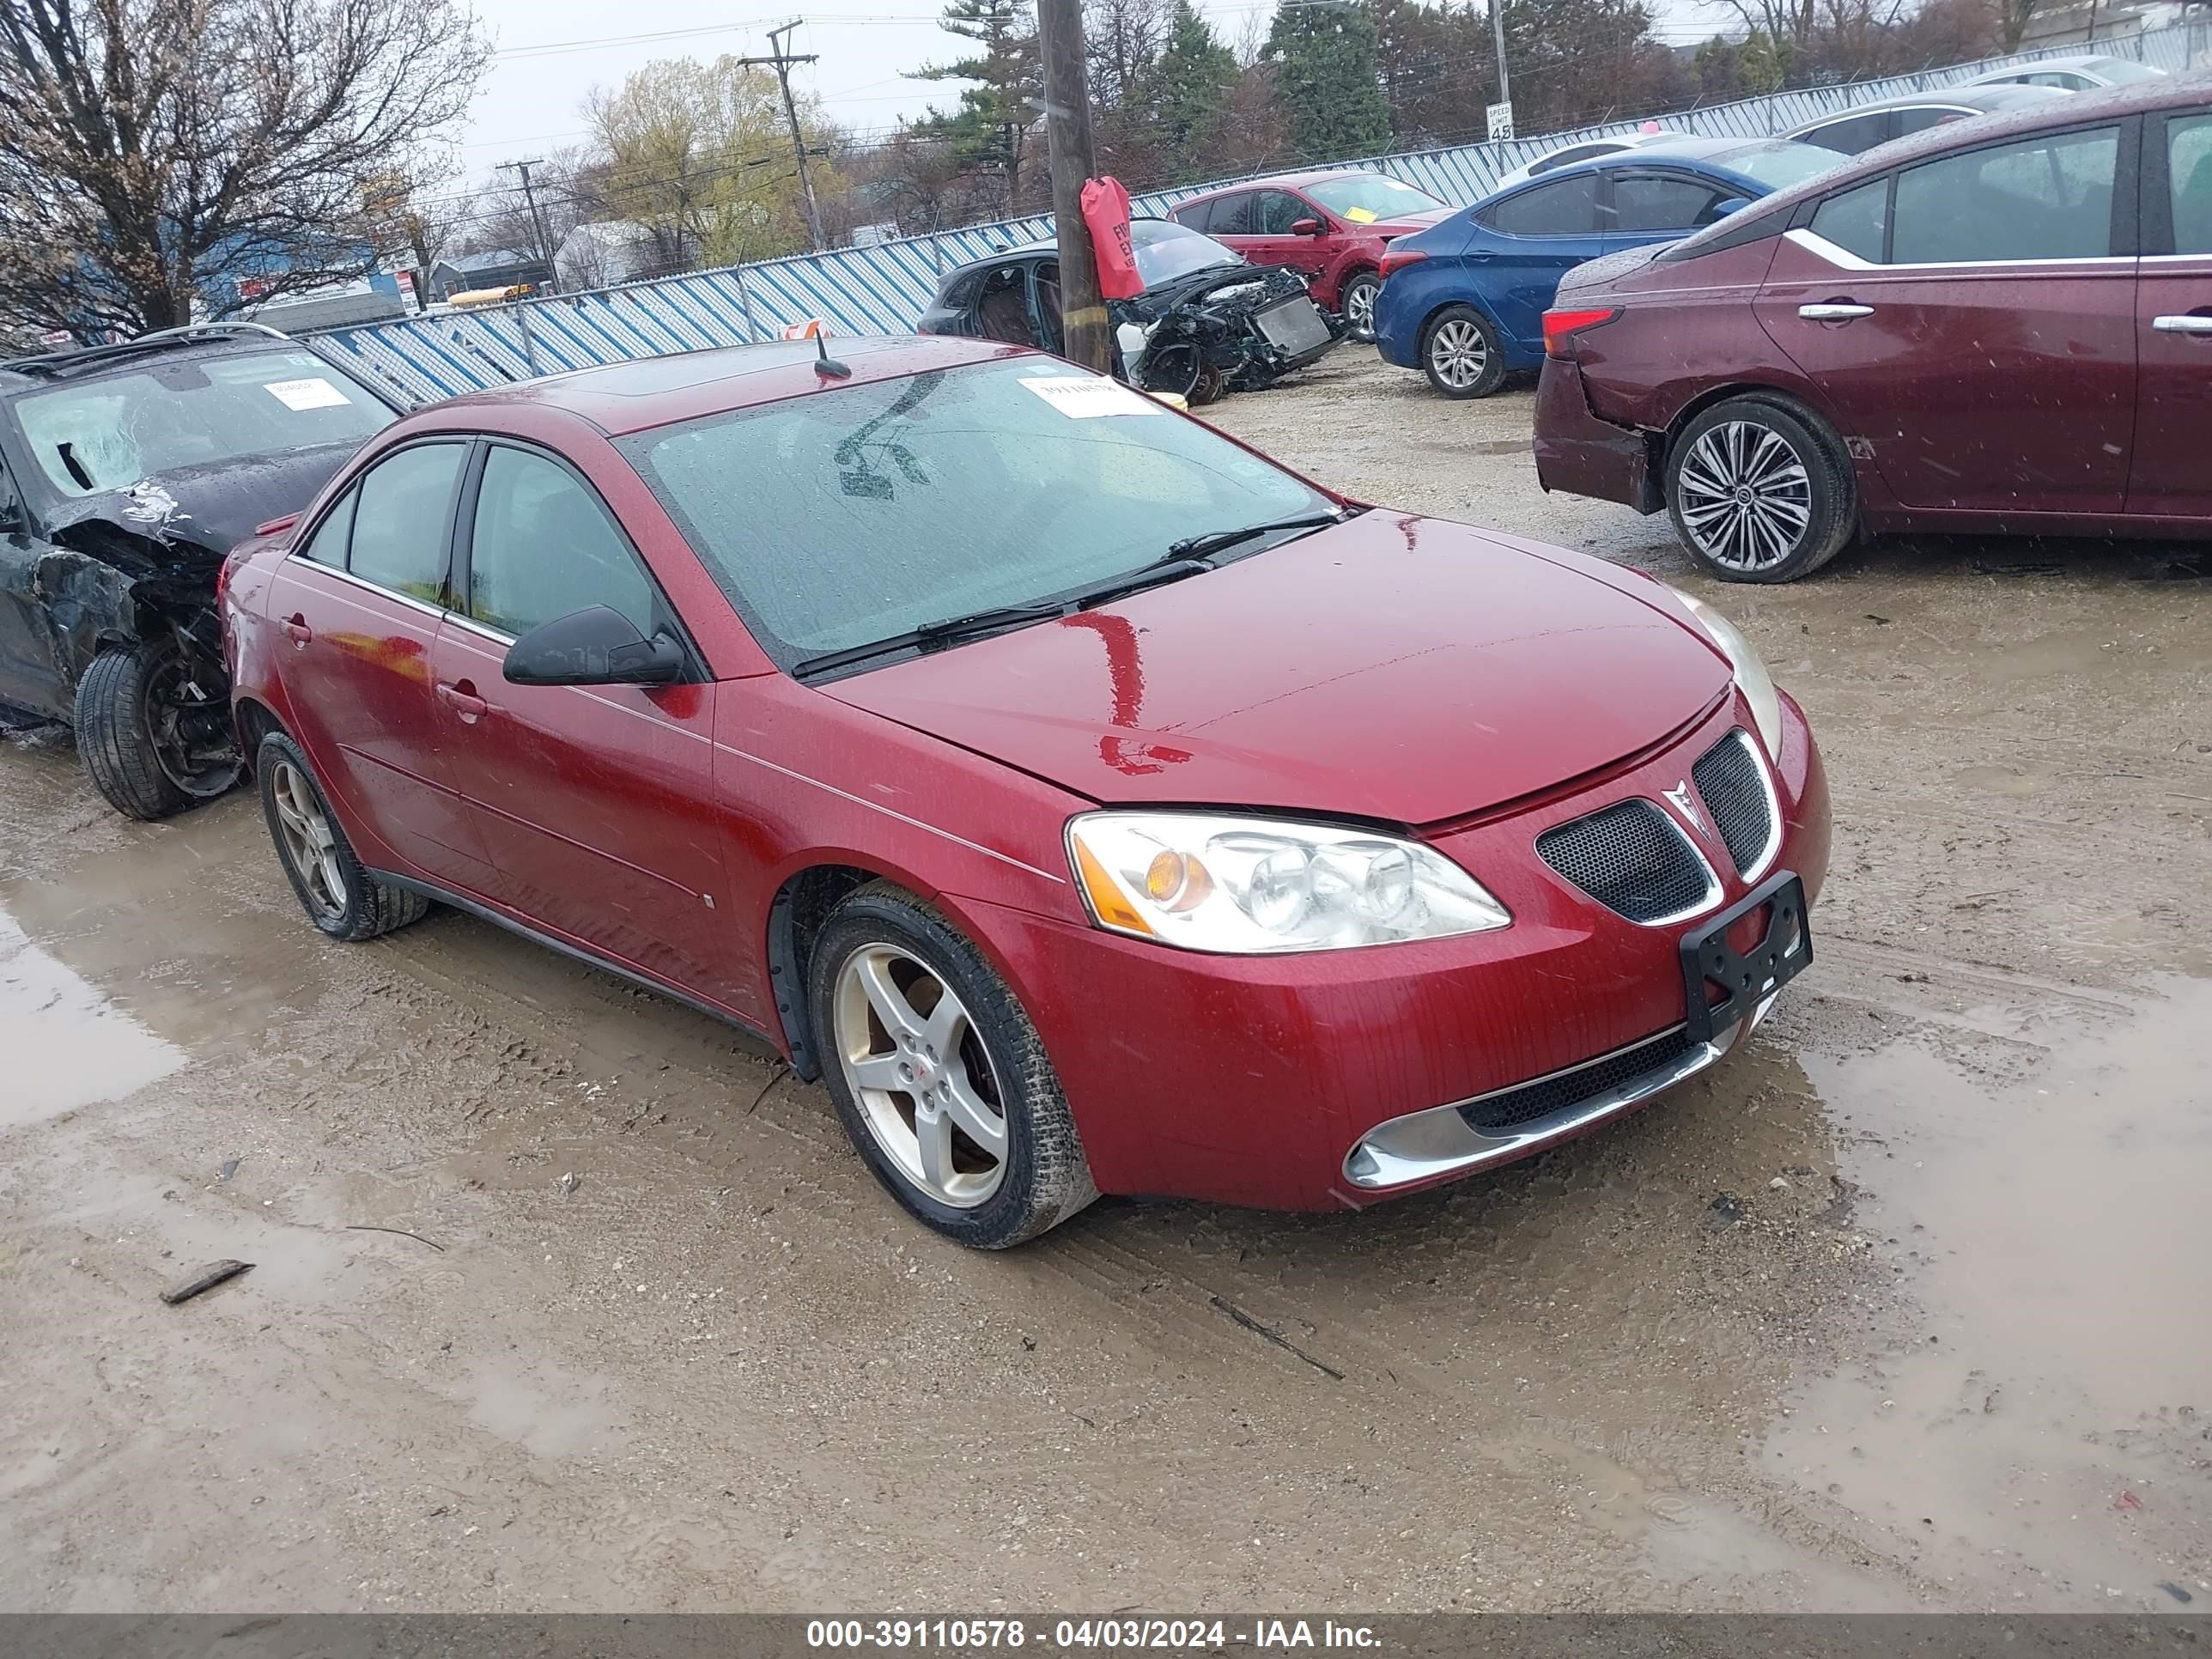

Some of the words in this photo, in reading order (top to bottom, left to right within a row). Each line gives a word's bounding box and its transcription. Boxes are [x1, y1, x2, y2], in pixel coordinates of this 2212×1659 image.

[1490, 107, 1510, 118] SPEED
[1492, 116, 1508, 125] LIMIT
[1492, 125, 1511, 141] 45
